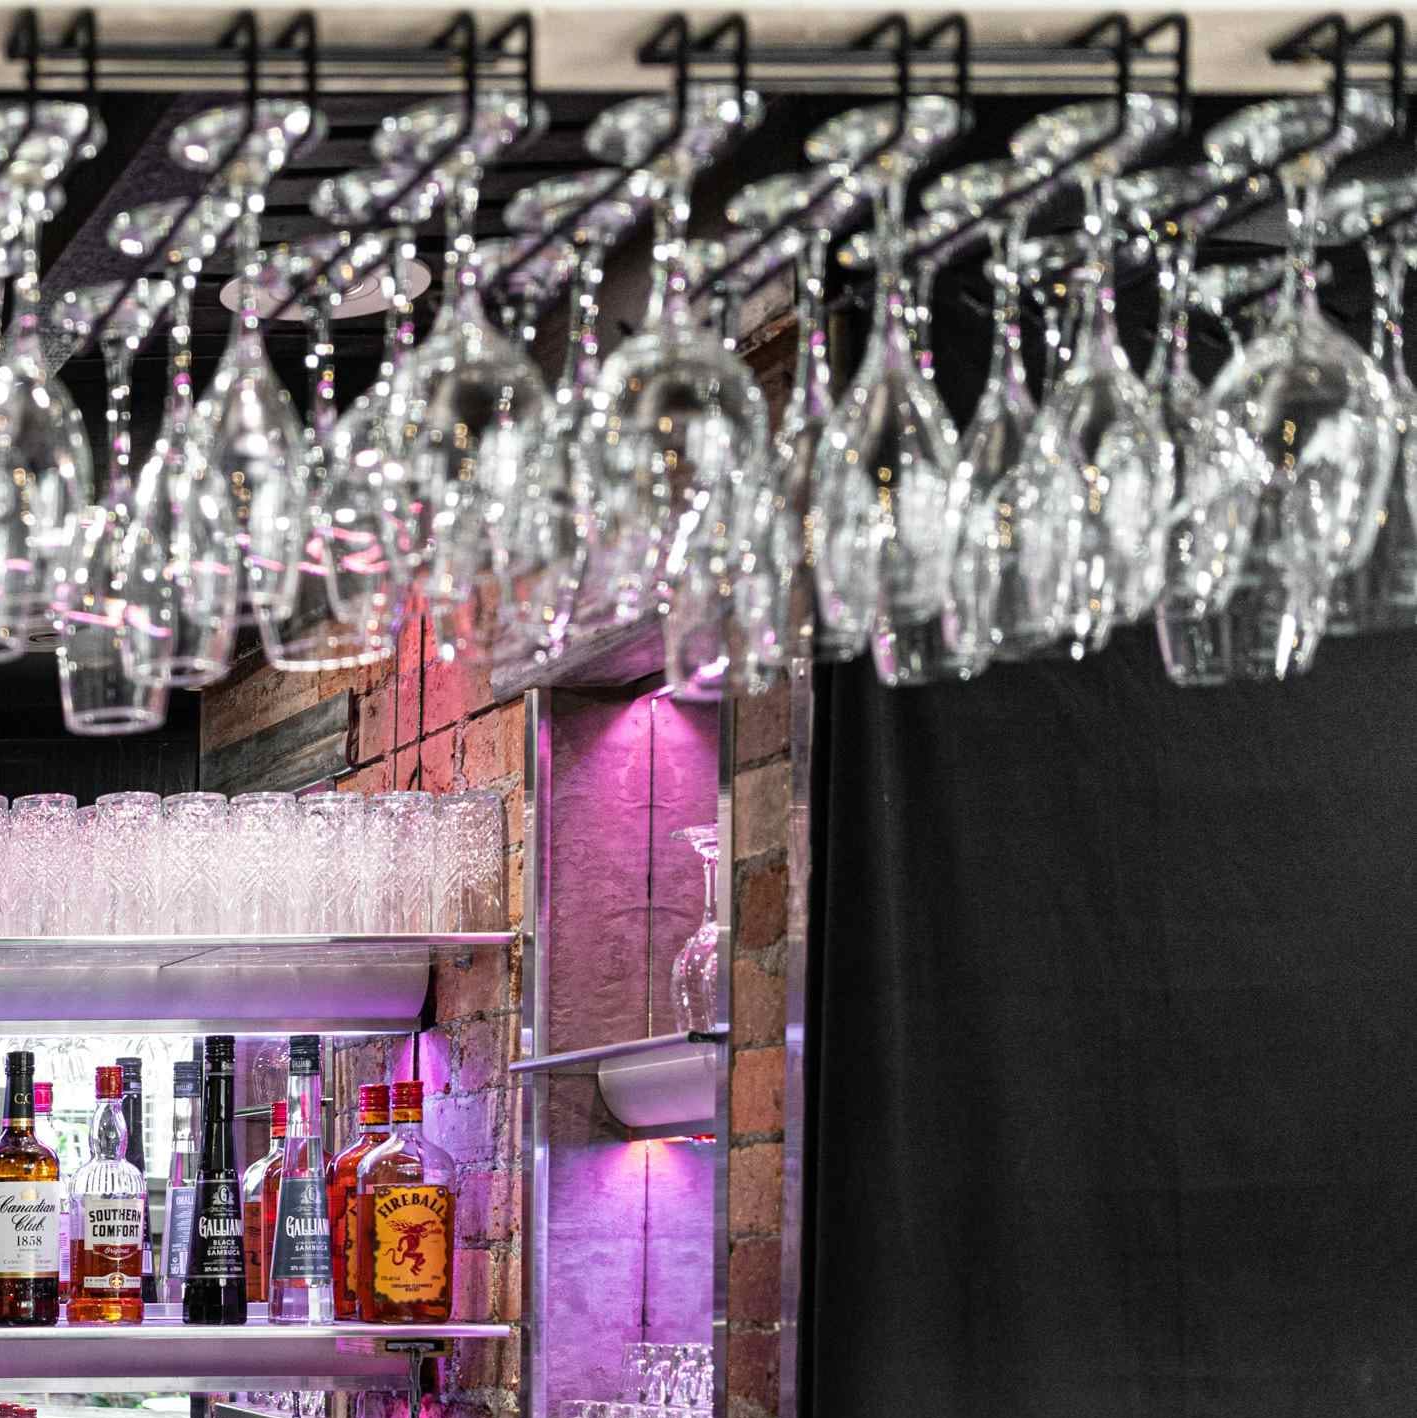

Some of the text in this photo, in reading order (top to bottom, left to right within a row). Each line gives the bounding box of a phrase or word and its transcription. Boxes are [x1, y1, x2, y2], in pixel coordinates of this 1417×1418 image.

[376, 1192, 445, 1218] FIREBALL
[89, 1208, 142, 1223] SOUTHERN
[93, 1224, 140, 1237] COMFORT
[199, 1216, 242, 1239] GALLIAN
[286, 1215, 330, 1238] GALLIAN
[17, 1235, 43, 1246] 1858
